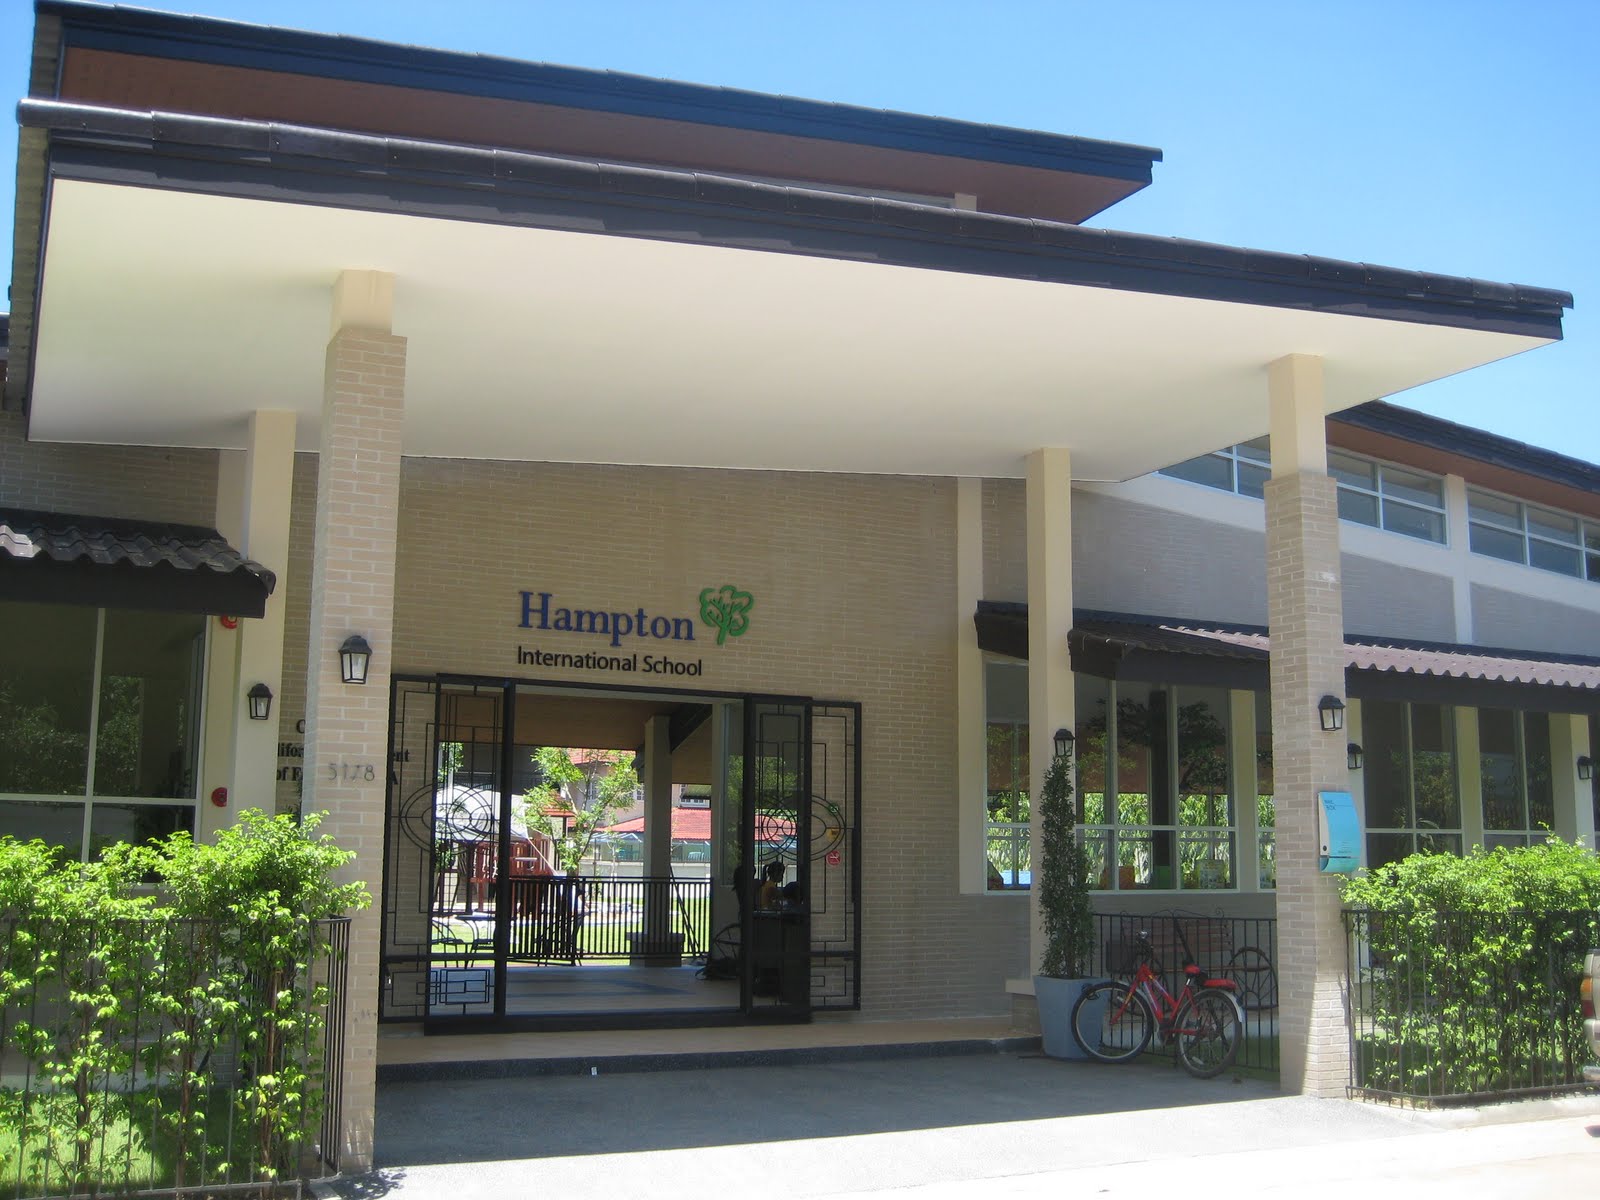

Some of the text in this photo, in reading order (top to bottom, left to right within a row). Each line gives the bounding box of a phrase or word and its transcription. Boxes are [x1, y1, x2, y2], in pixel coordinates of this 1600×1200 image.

[518, 590, 696, 647] Hampton
[517, 645, 702, 677] International School
